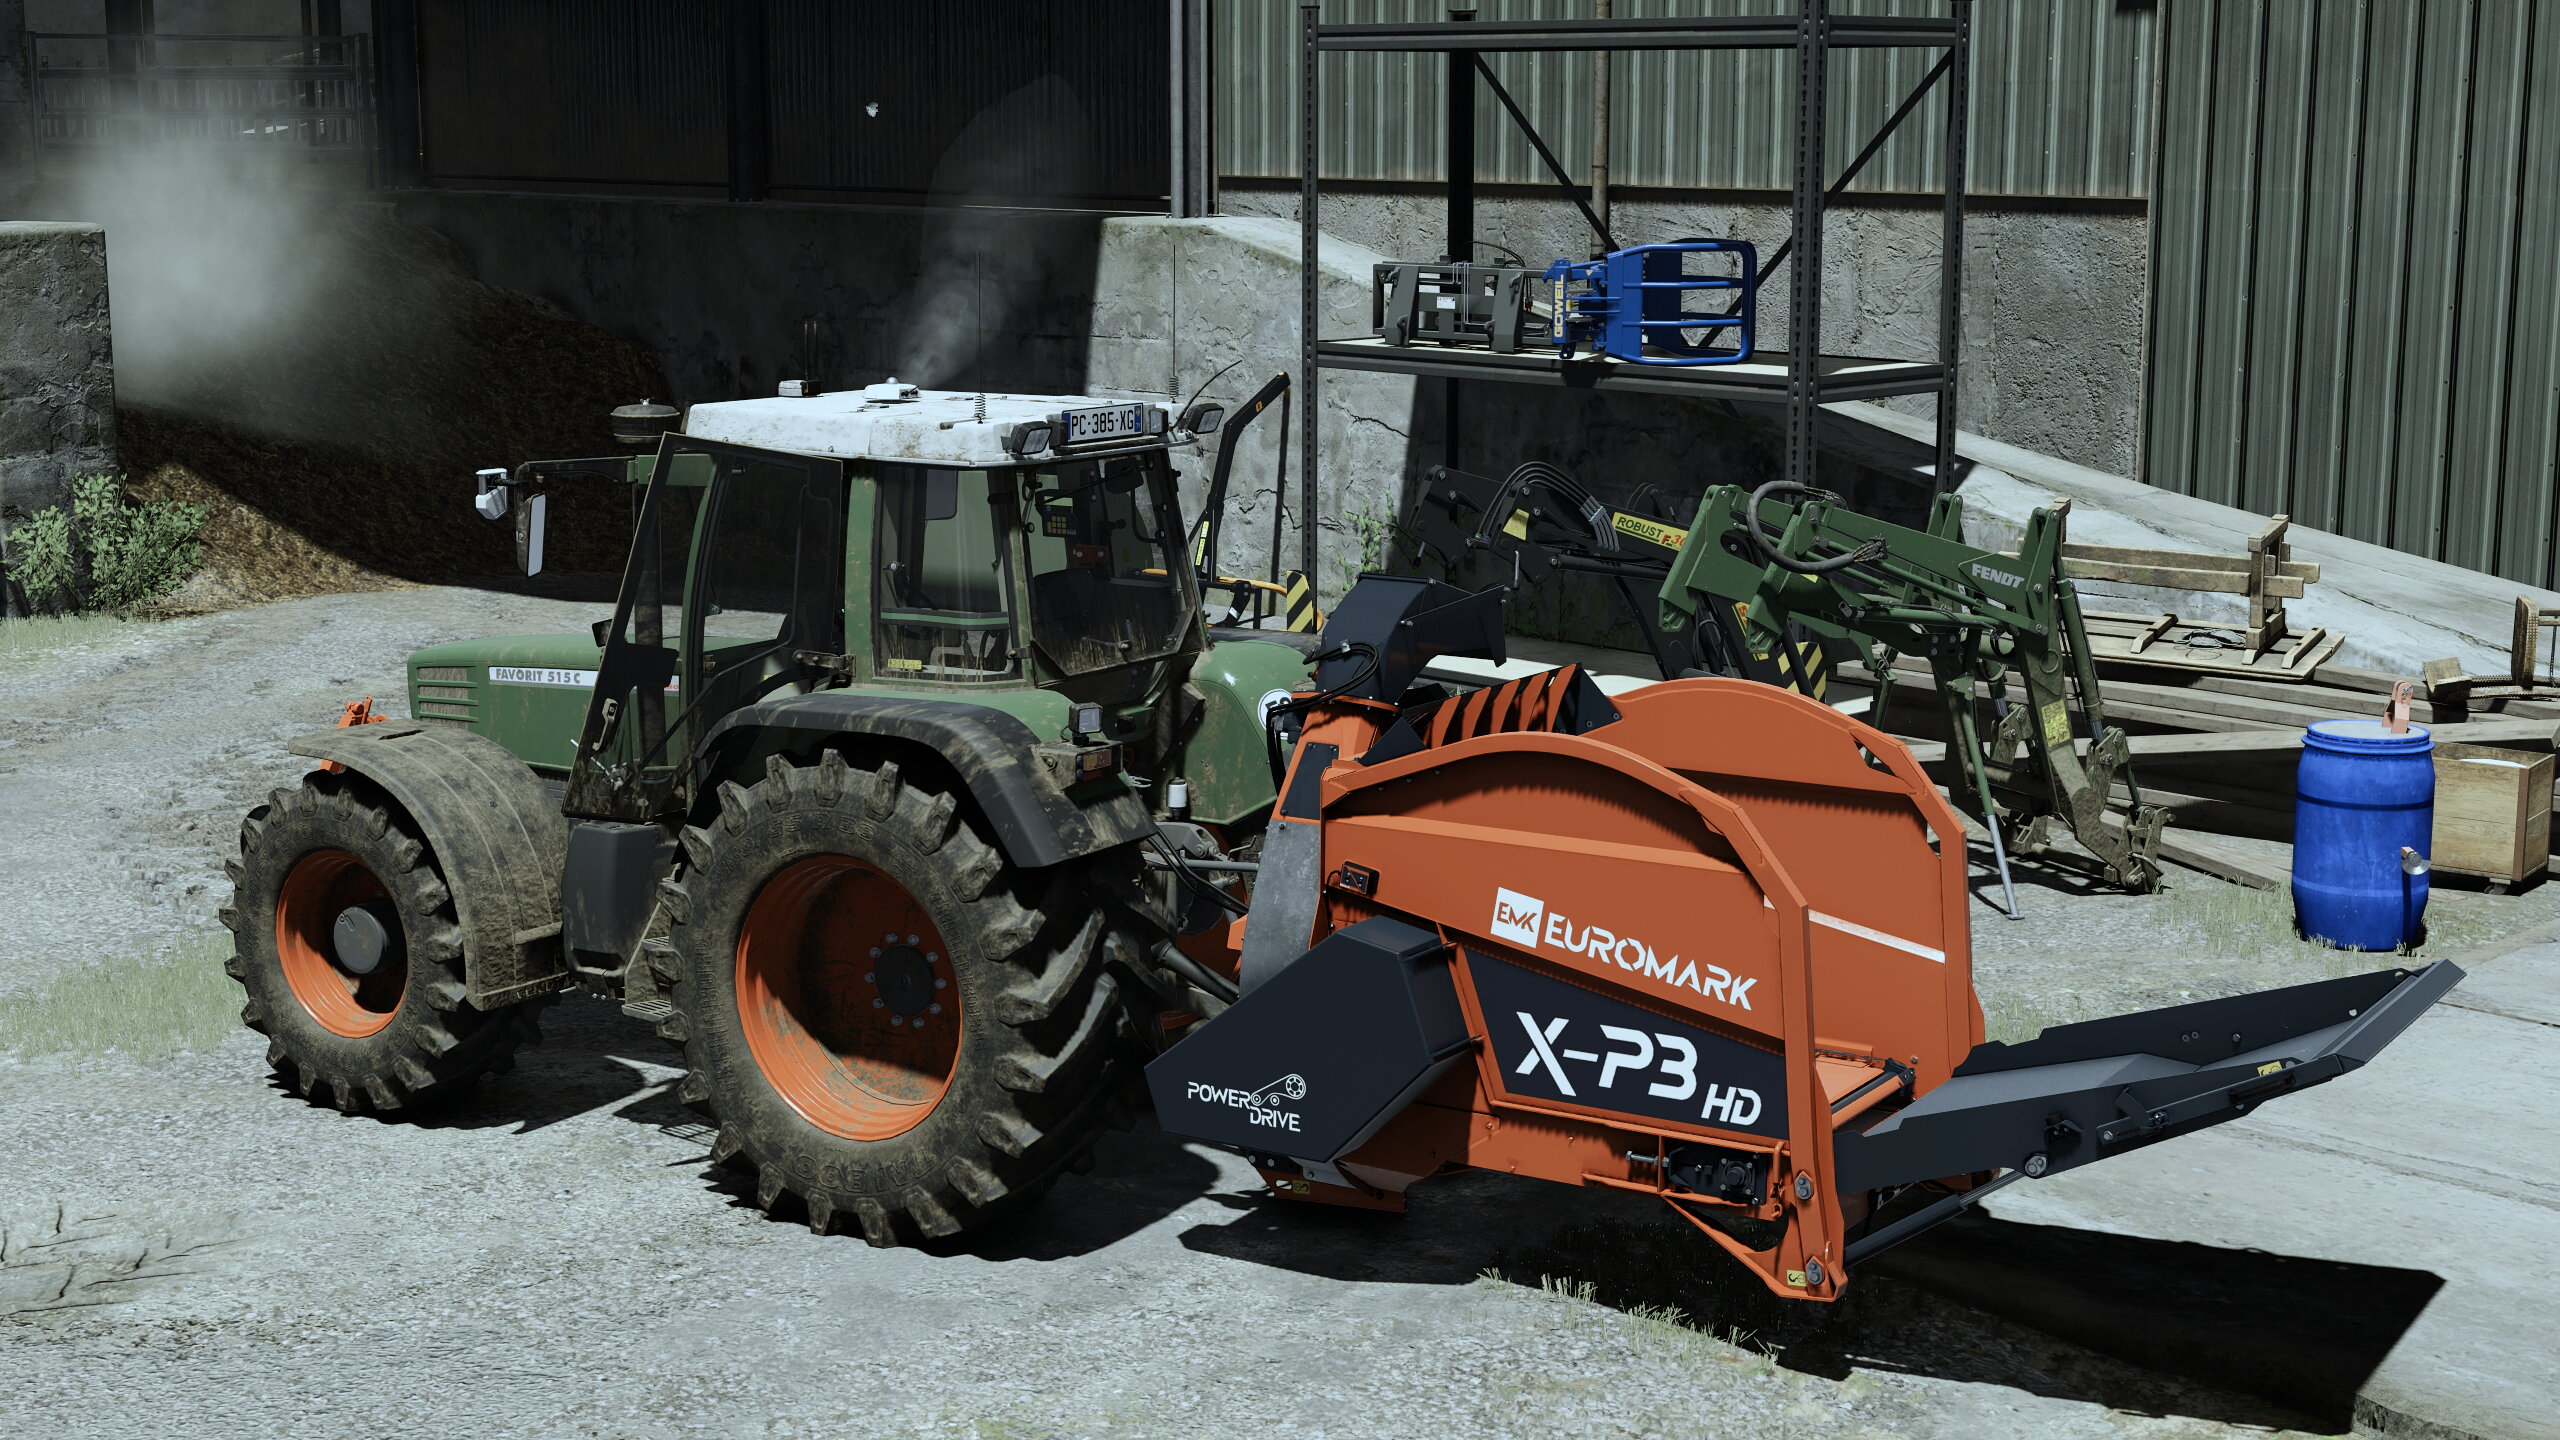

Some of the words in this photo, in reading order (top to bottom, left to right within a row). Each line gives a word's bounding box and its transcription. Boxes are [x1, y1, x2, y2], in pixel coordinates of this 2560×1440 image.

[1617, 517, 1664, 538] ROBUST
[1971, 563, 2026, 589] FENDT
[495, 668, 543, 682] FAVORIT
[1496, 901, 1538, 934] EMK
[1544, 911, 1758, 1011] EUROMARK
[1515, 1011, 1699, 1101] X-P3
[1700, 1082, 1762, 1127] HD
[1187, 1081, 1251, 1110] POWER
[1250, 1105, 1301, 1133] DRIVE
